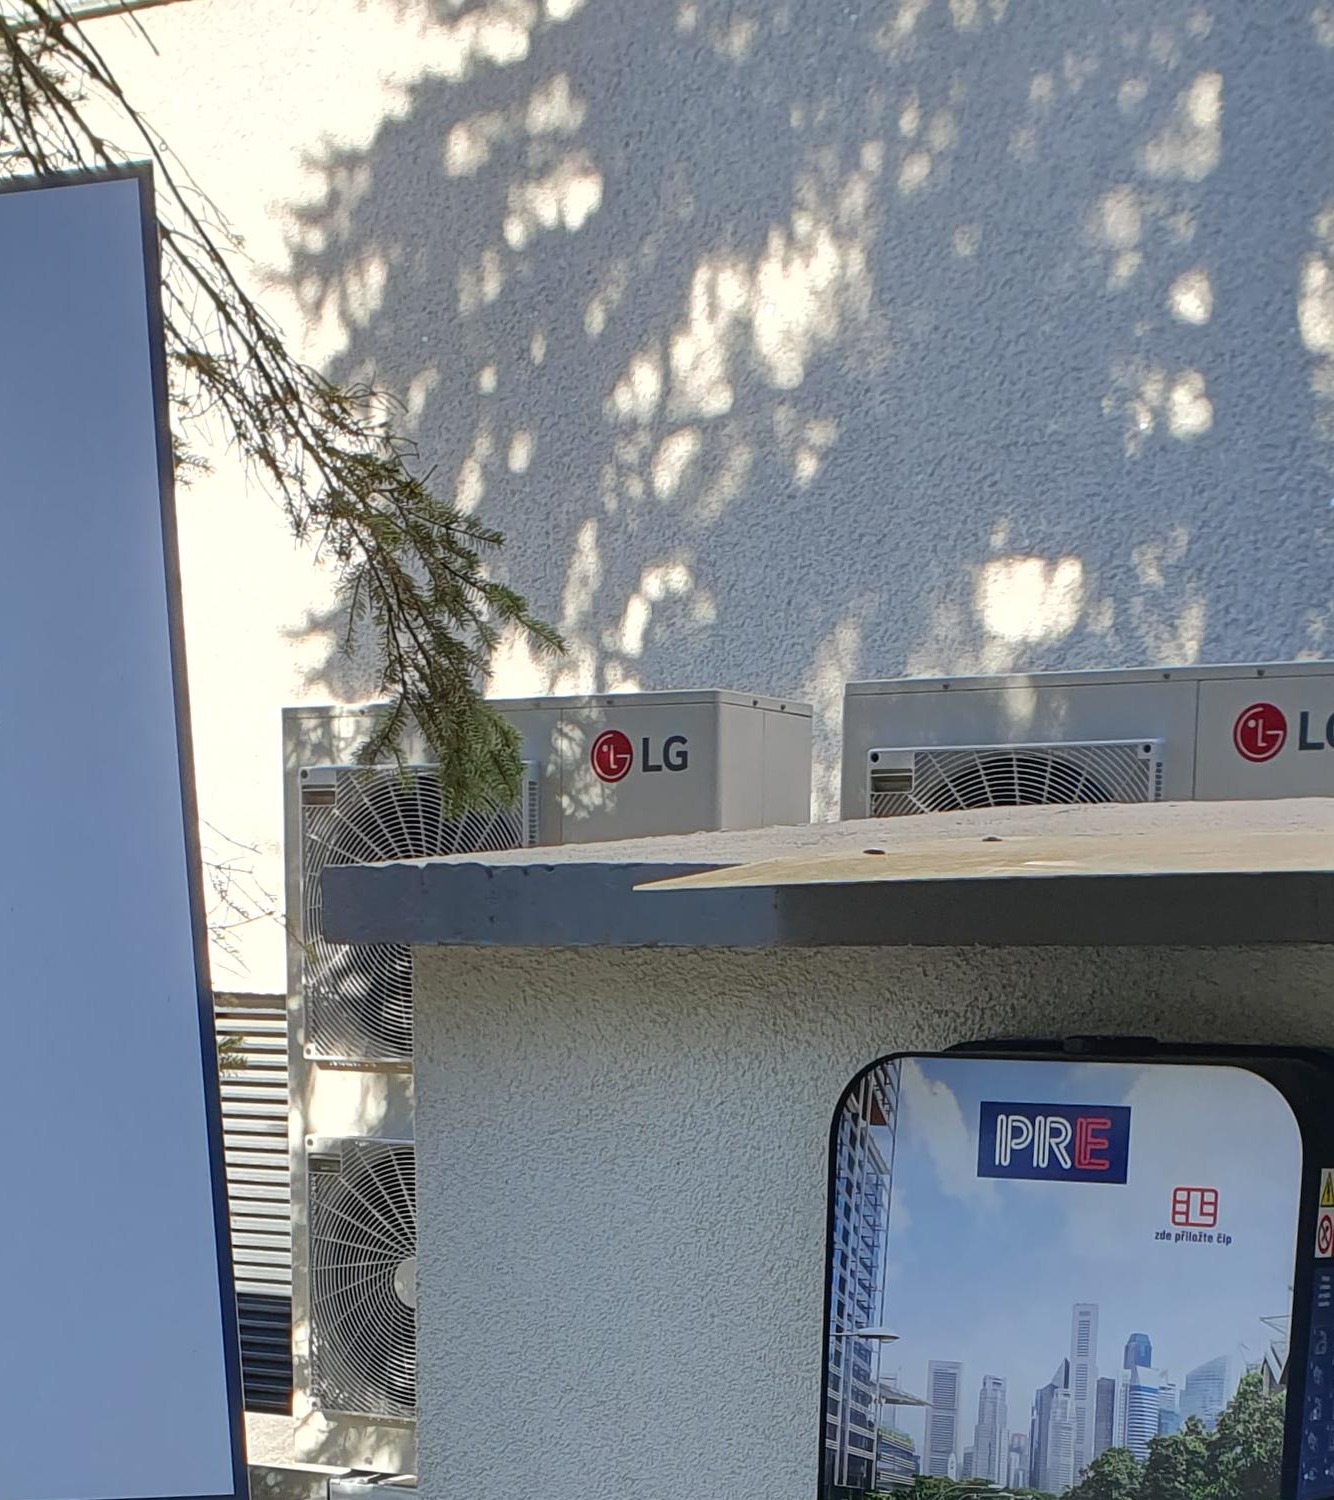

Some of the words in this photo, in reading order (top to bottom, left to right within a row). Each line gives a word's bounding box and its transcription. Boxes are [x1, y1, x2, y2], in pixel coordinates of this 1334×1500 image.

[642, 735, 689, 773] LG
[994, 1114, 1111, 1171] PRE
[1154, 1229, 1172, 1240] zde
[1175, 1230, 1213, 1243] přiložte
[1216, 1232, 1232, 1246] čip
